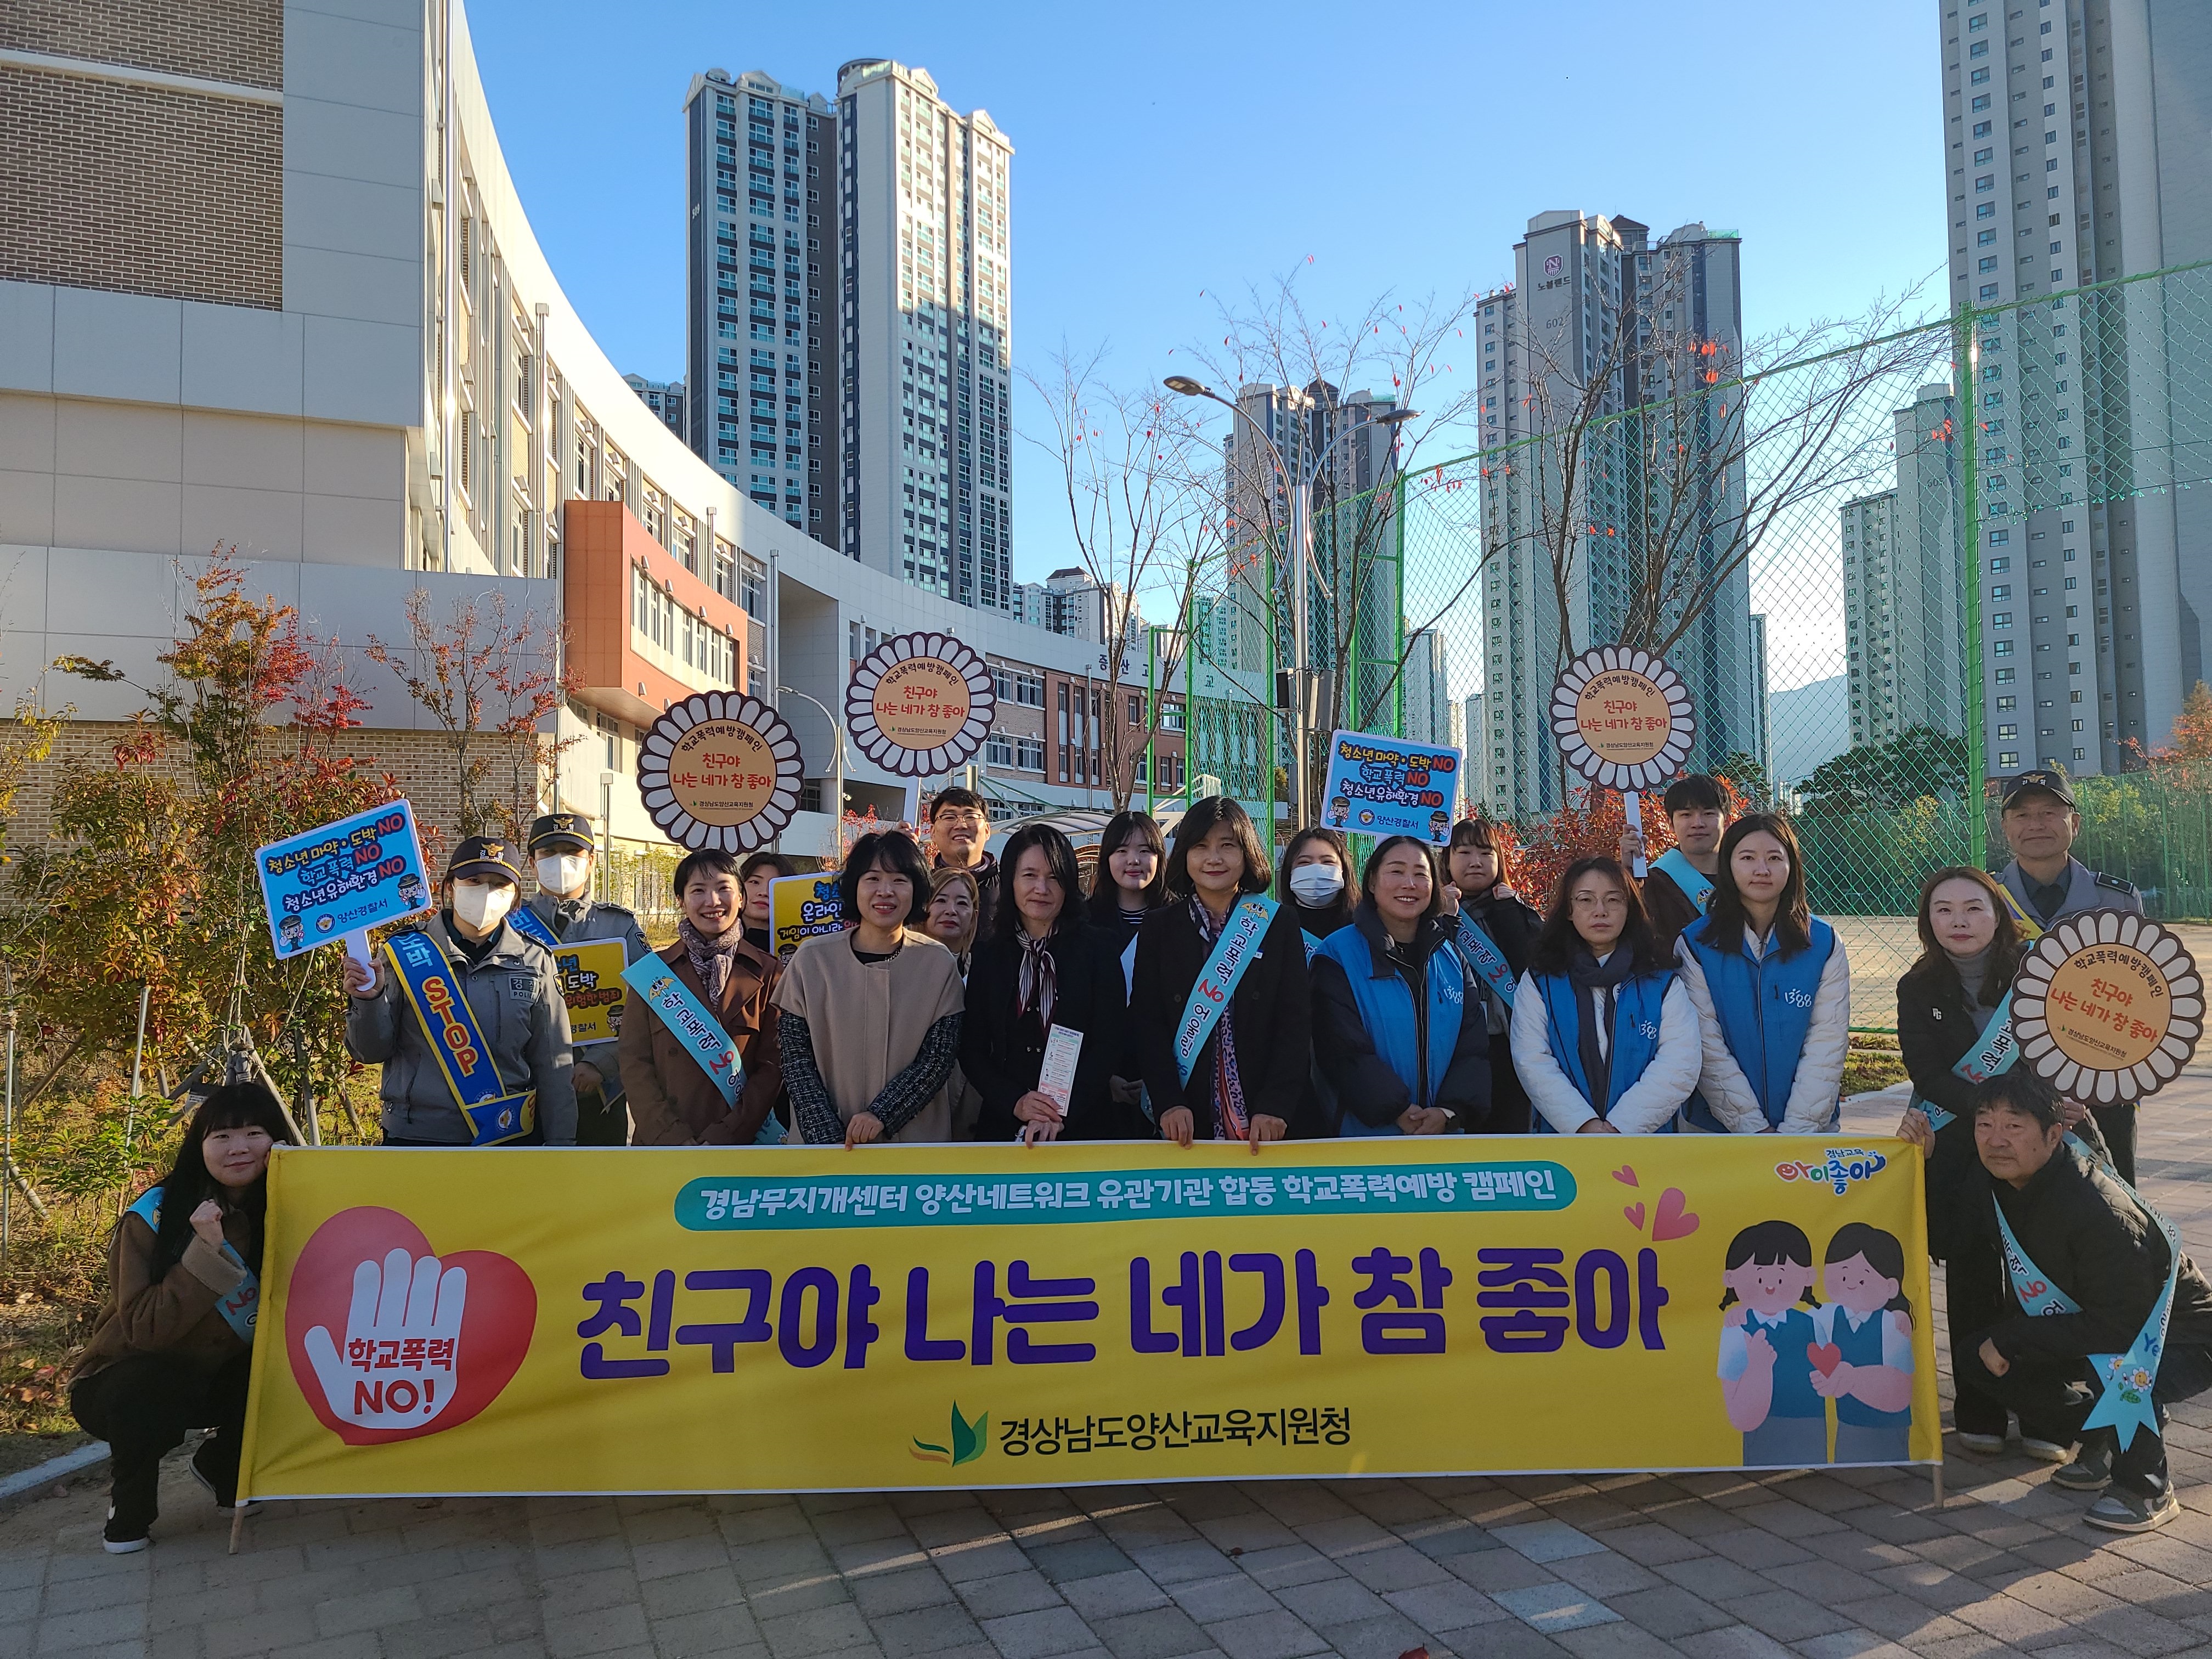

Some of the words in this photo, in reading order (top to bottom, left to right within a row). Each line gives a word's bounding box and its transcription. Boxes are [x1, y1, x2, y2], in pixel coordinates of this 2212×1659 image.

[692, 203, 700, 219] 509
[1546, 318, 1564, 329] 602
[903, 686, 938, 700] 친구야
[876, 702, 898, 716] 나는
[901, 704, 925, 715] 네가
[927, 704, 940, 718] 참
[942, 704, 965, 719] 좋아
[1604, 701, 1638, 714] 친구야
[1581, 718, 1602, 732] 나는
[1605, 719, 1628, 730] 네가
[1630, 717, 1643, 731] 참
[1645, 717, 1667, 731] 좋아
[702, 753, 741, 769] 친구야
[1340, 743, 1373, 761] 청소년
[1433, 757, 1454, 771] NO
[673, 772, 698, 788] 나는
[701, 774, 728, 787] 네가
[731, 773, 744, 789] 참
[747, 774, 771, 789] 좋아
[1407, 772, 1428, 786] NO
[1420, 793, 1442, 806] NO
[1377, 815, 1419, 830] 양산경찰서
[268, 851, 309, 874] 청소년
[377, 815, 403, 835] NO
[355, 845, 380, 864] NO
[379, 858, 403, 878] NO
[337, 899, 388, 923] 양산경찰서
[803, 902, 842, 922] 온라인
[780, 927, 810, 940] 게임이
[811, 923, 843, 934] 아니라
[568, 973, 596, 988] 도박
[565, 991, 597, 1007] 위험한
[599, 990, 619, 1003] 범죄
[1198, 979, 1225, 1003] No
[1785, 990, 1812, 1008] 1388
[2091, 978, 2133, 1007] 친구야
[2050, 988, 2078, 1012] 나는
[2080, 1000, 2111, 1023] 네가
[2113, 1012, 2129, 1032] 참
[2130, 1018, 2158, 1043] 좋아
[422, 976, 479, 1077] STOP
[709, 1050, 734, 1076] No
[1826, 1148, 1865, 1159] 경남교육
[1775, 1155, 1886, 1195] 아이좋아
[700, 1185, 909, 1220] 경남무지개센터
[915, 1179, 1091, 1216] 양산네트워크
[1097, 1178, 1214, 1209] 유관기관
[1218, 1175, 1277, 1206] 합동
[1281, 1171, 1457, 1204] 학교폭력예방
[1463, 1169, 1557, 1201] 캠페인
[2019, 1280, 2047, 1304] No
[577, 1263, 881, 1380] 친구야
[904, 1260, 1100, 1366] 나는
[1130, 1249, 1330, 1357] 네가
[1351, 1246, 1453, 1355] 참
[1477, 1247, 1669, 1353] 좋아
[348, 1337, 455, 1373] 학교폭력
[354, 1379, 435, 1415] NO!
[1000, 1407, 1351, 1457] 경상남도양산교육지원청
